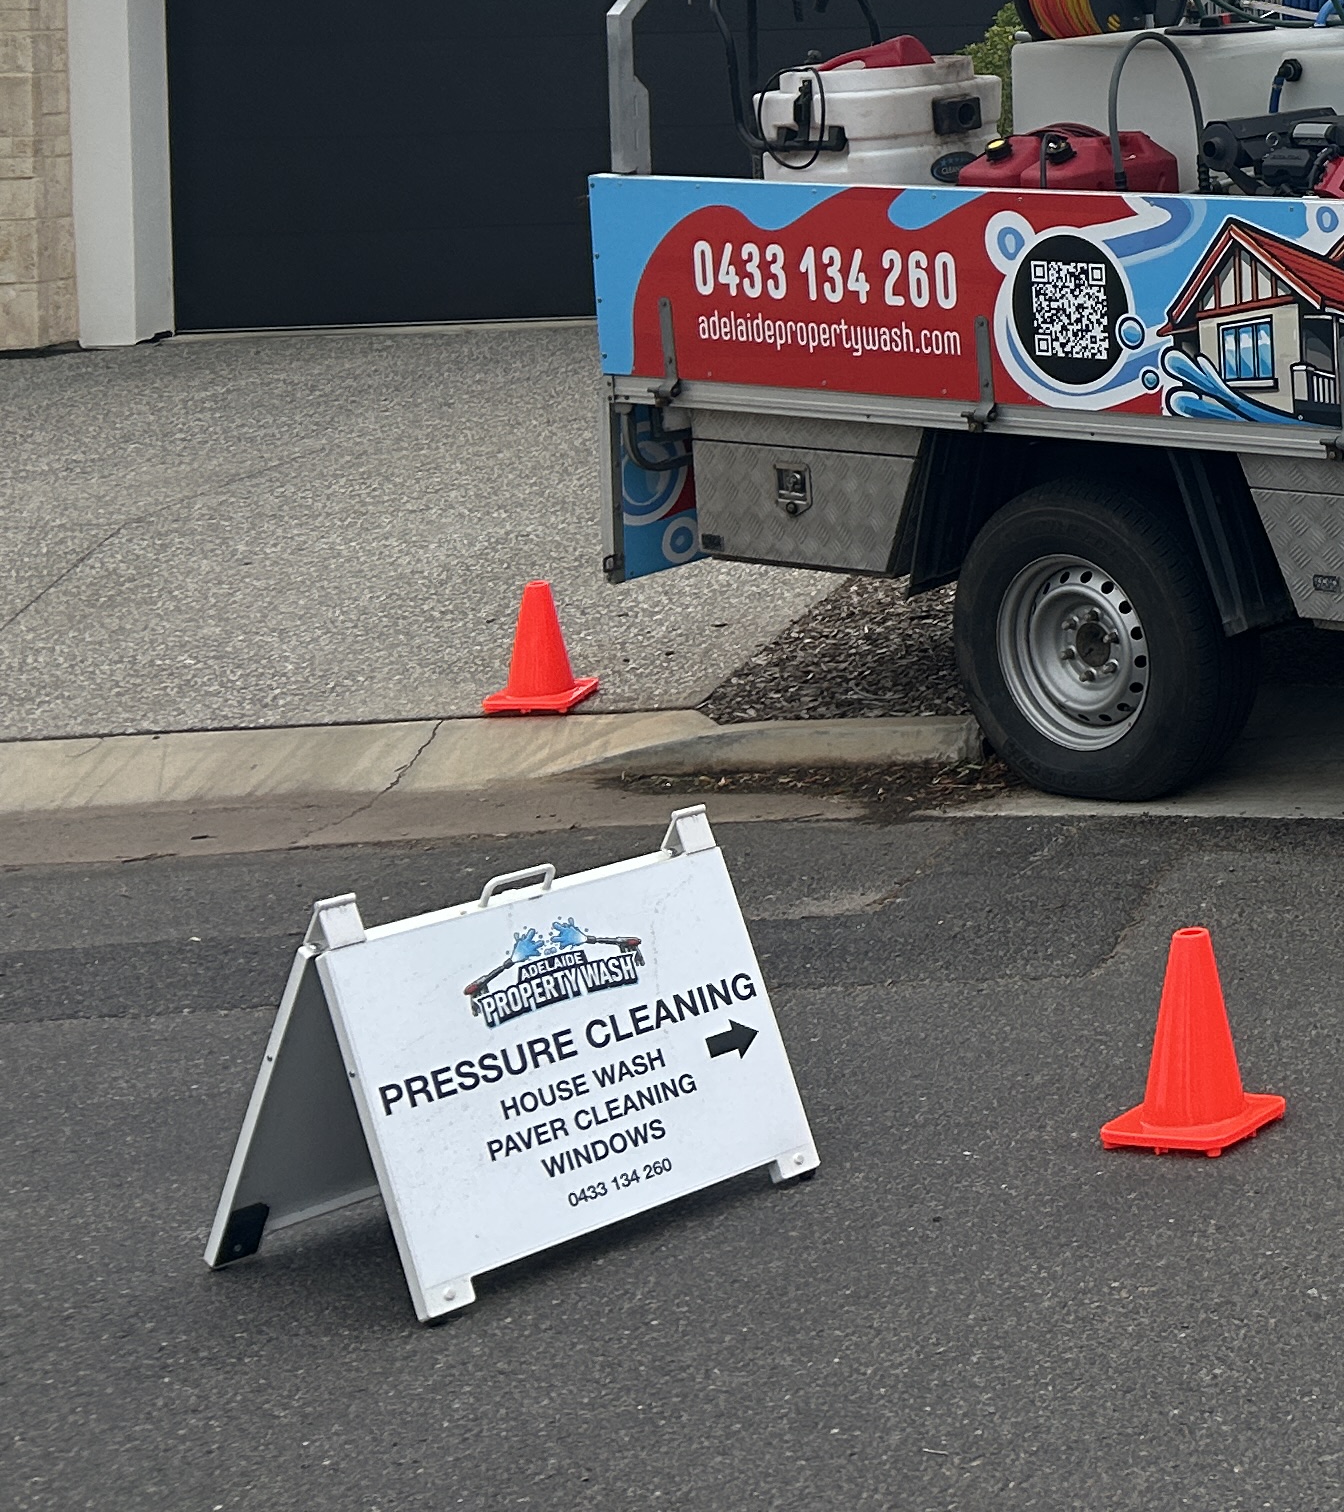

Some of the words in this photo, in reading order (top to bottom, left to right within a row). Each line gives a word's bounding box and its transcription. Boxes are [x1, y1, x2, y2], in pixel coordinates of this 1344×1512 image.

[693, 240, 787, 300] 0433
[799, 246, 870, 305] 134
[882, 249, 958, 310] 260
[698, 309, 962, 357] adelaidepropertywash.com
[521, 951, 584, 979] ADELAIDE
[378, 1029, 578, 1116] PRESSURE
[585, 972, 758, 1049] CLEANING
[500, 1073, 590, 1120] HOUSE
[592, 1048, 667, 1088] WASH
[486, 1117, 569, 1162] PAVER
[574, 1073, 698, 1131] CLEANING
[541, 1118, 667, 1178] WINDOWS
[568, 1181, 608, 1207] 0433
[611, 1169, 641, 1192] 134
[643, 1157, 673, 1181] 260
